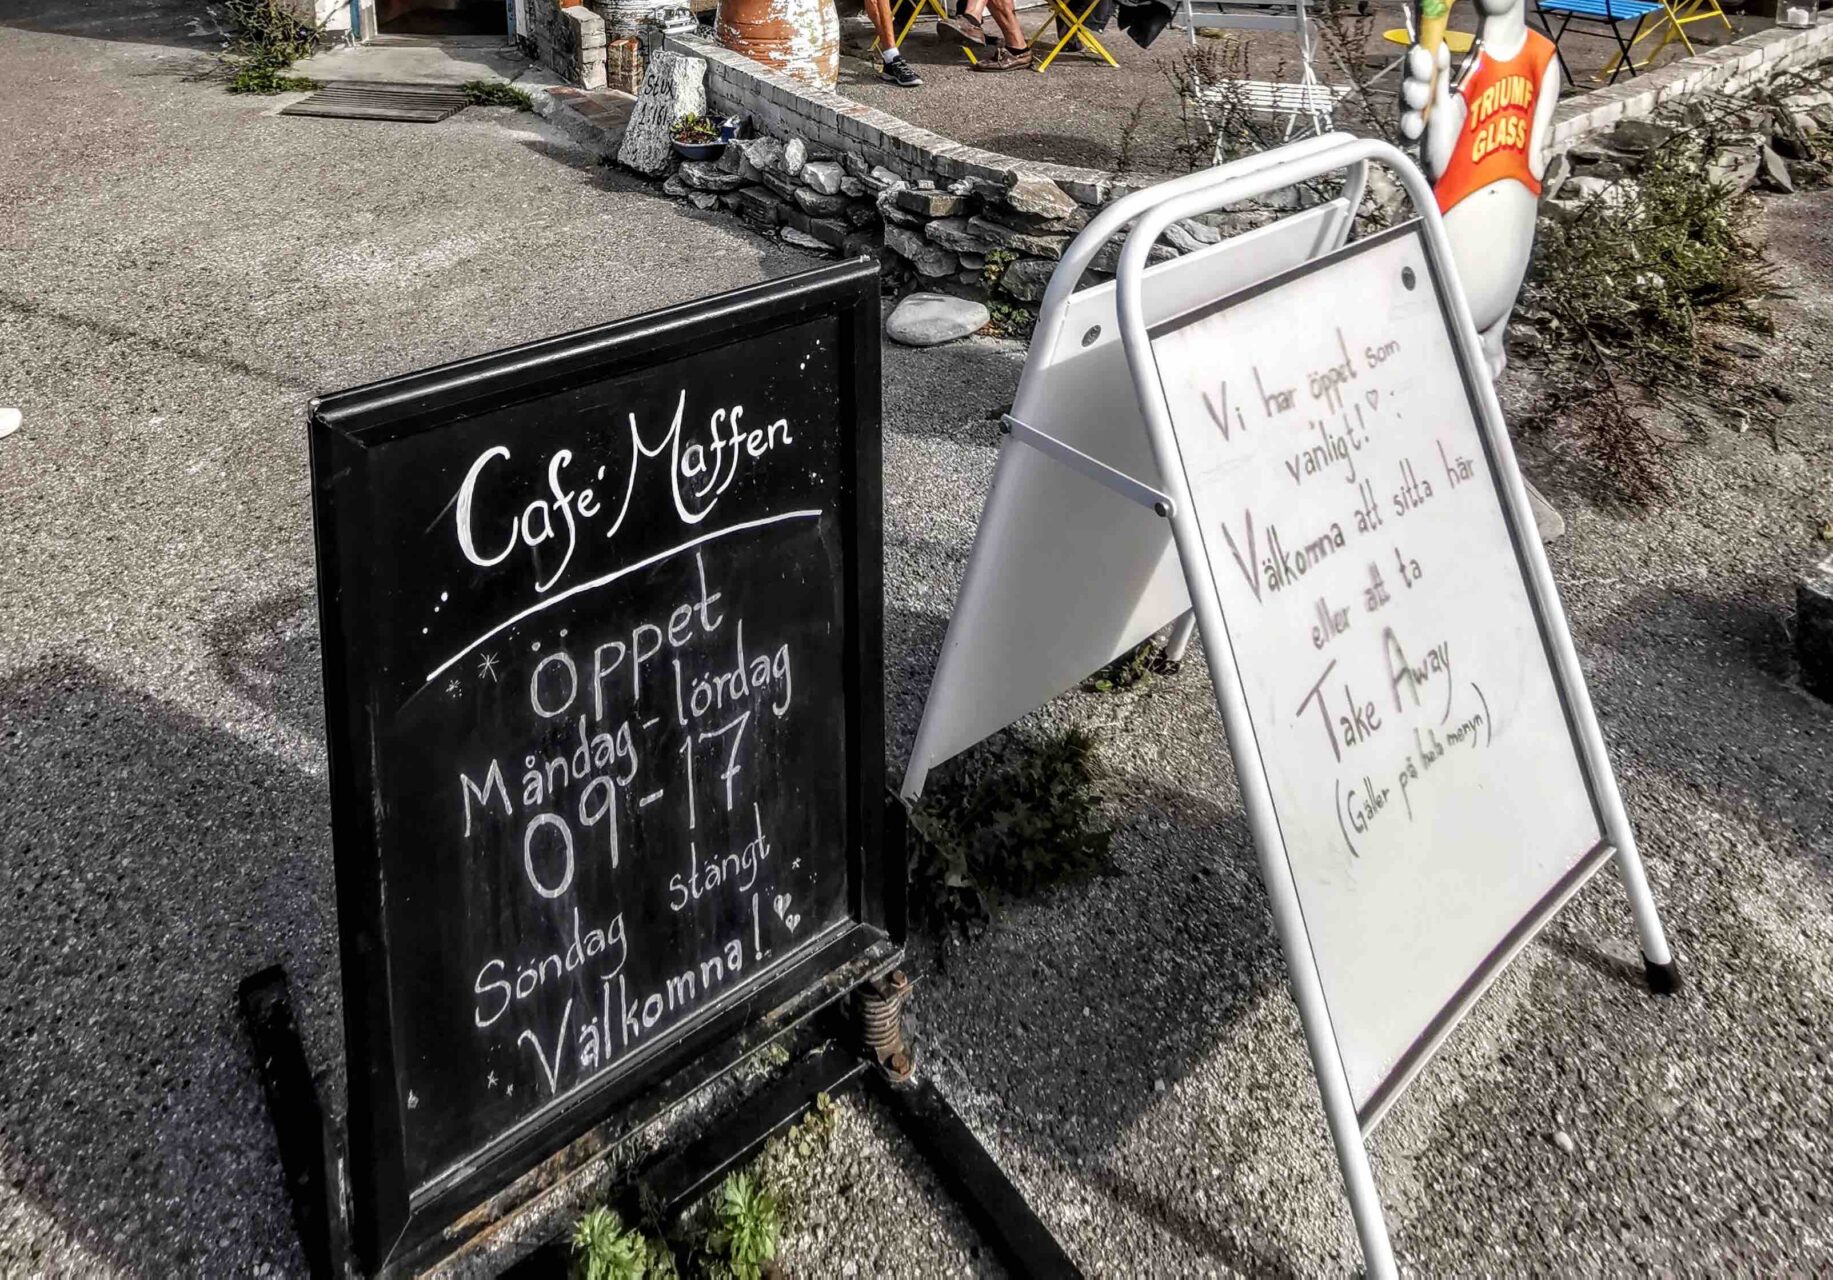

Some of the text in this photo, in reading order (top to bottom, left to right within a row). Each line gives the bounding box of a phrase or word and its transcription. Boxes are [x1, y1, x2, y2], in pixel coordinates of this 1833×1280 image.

[1471, 75, 1533, 131] TRIUMF
[1471, 115, 1526, 162] GLASS
[1202, 380, 1246, 442] Vi
[1252, 365, 1297, 418] har
[1308, 326, 1357, 415] öppet
[455, 388, 794, 593] Café Maffen
[1221, 439, 1476, 604] Välkomna att sitta här
[1311, 546, 1423, 650] eller att ta
[1296, 625, 1453, 763] Take Away
[1398, 755, 1419, 822] på
[472, 906, 628, 1028] Söndag
